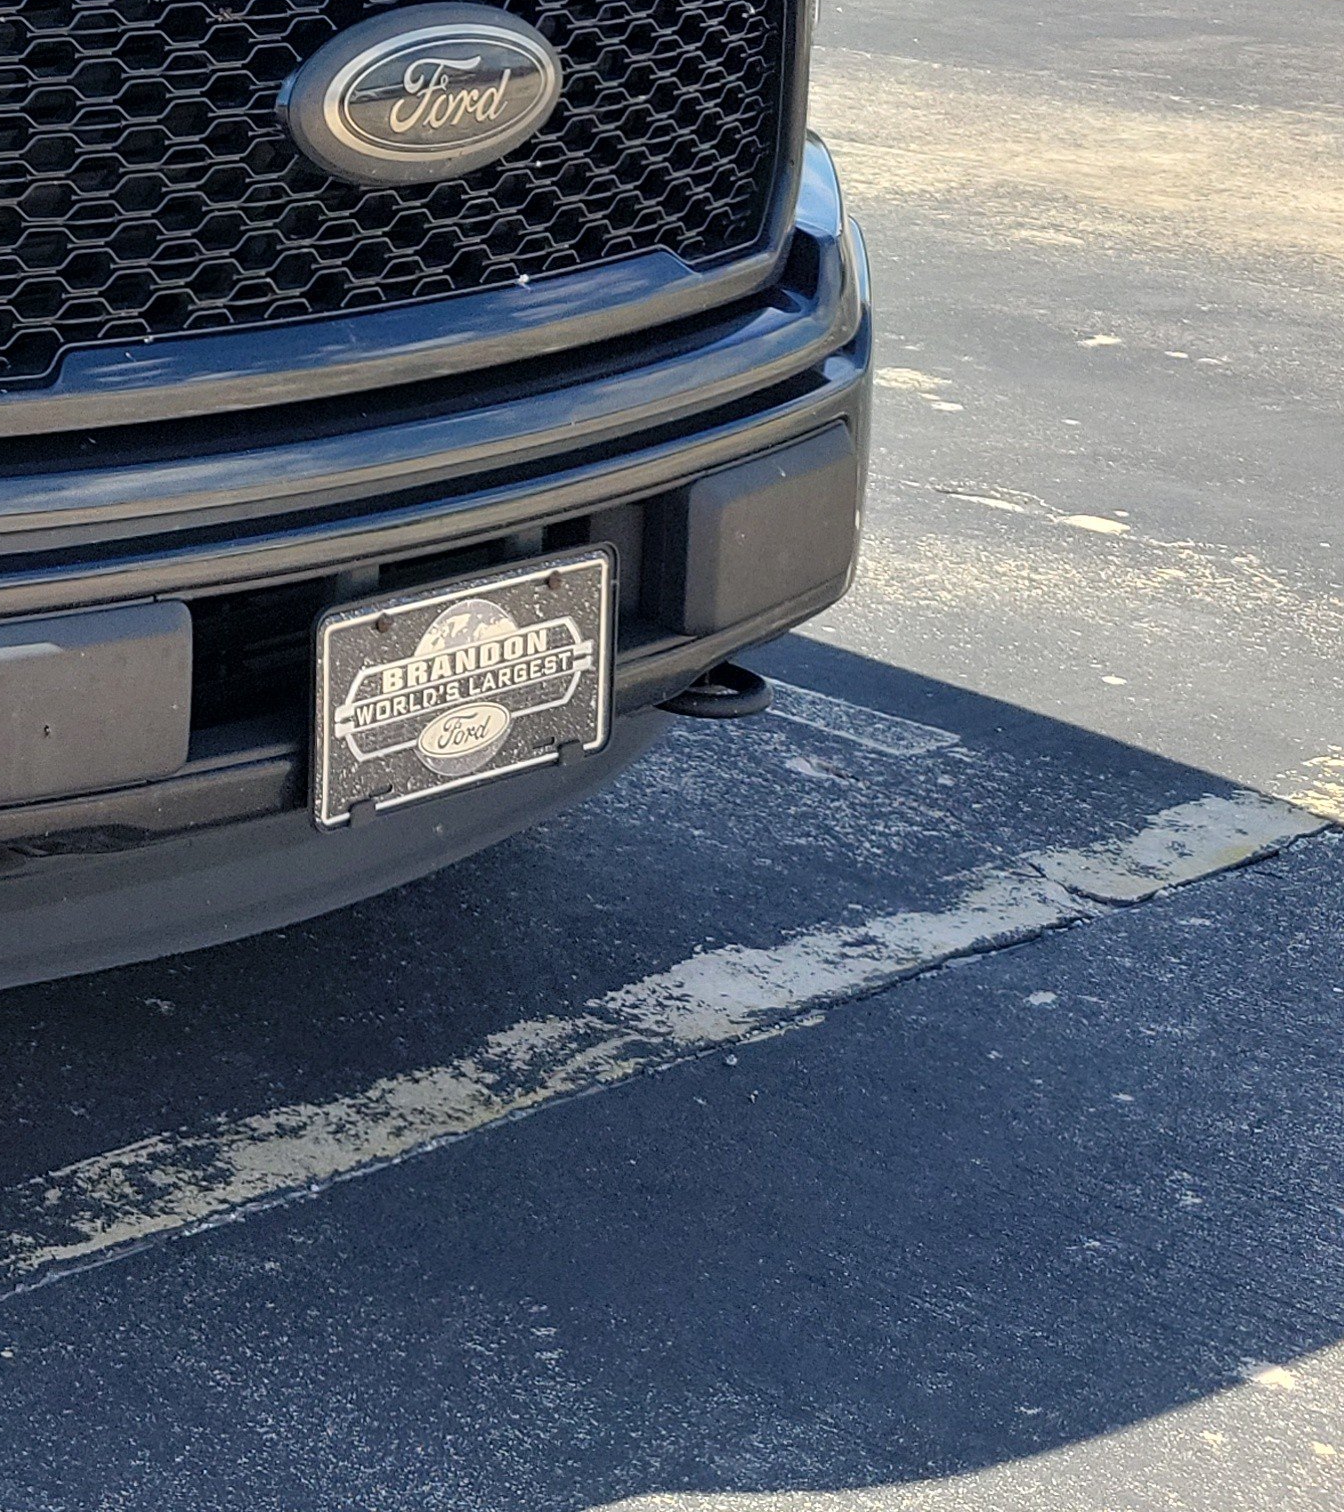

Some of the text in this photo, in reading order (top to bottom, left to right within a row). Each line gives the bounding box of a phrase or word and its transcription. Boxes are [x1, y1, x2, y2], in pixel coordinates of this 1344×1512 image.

[389, 55, 511, 134] Ford
[355, 651, 573, 727] WORLD'S LARGEST
[381, 629, 548, 694] BRANDON
[437, 712, 491, 749] Ford
